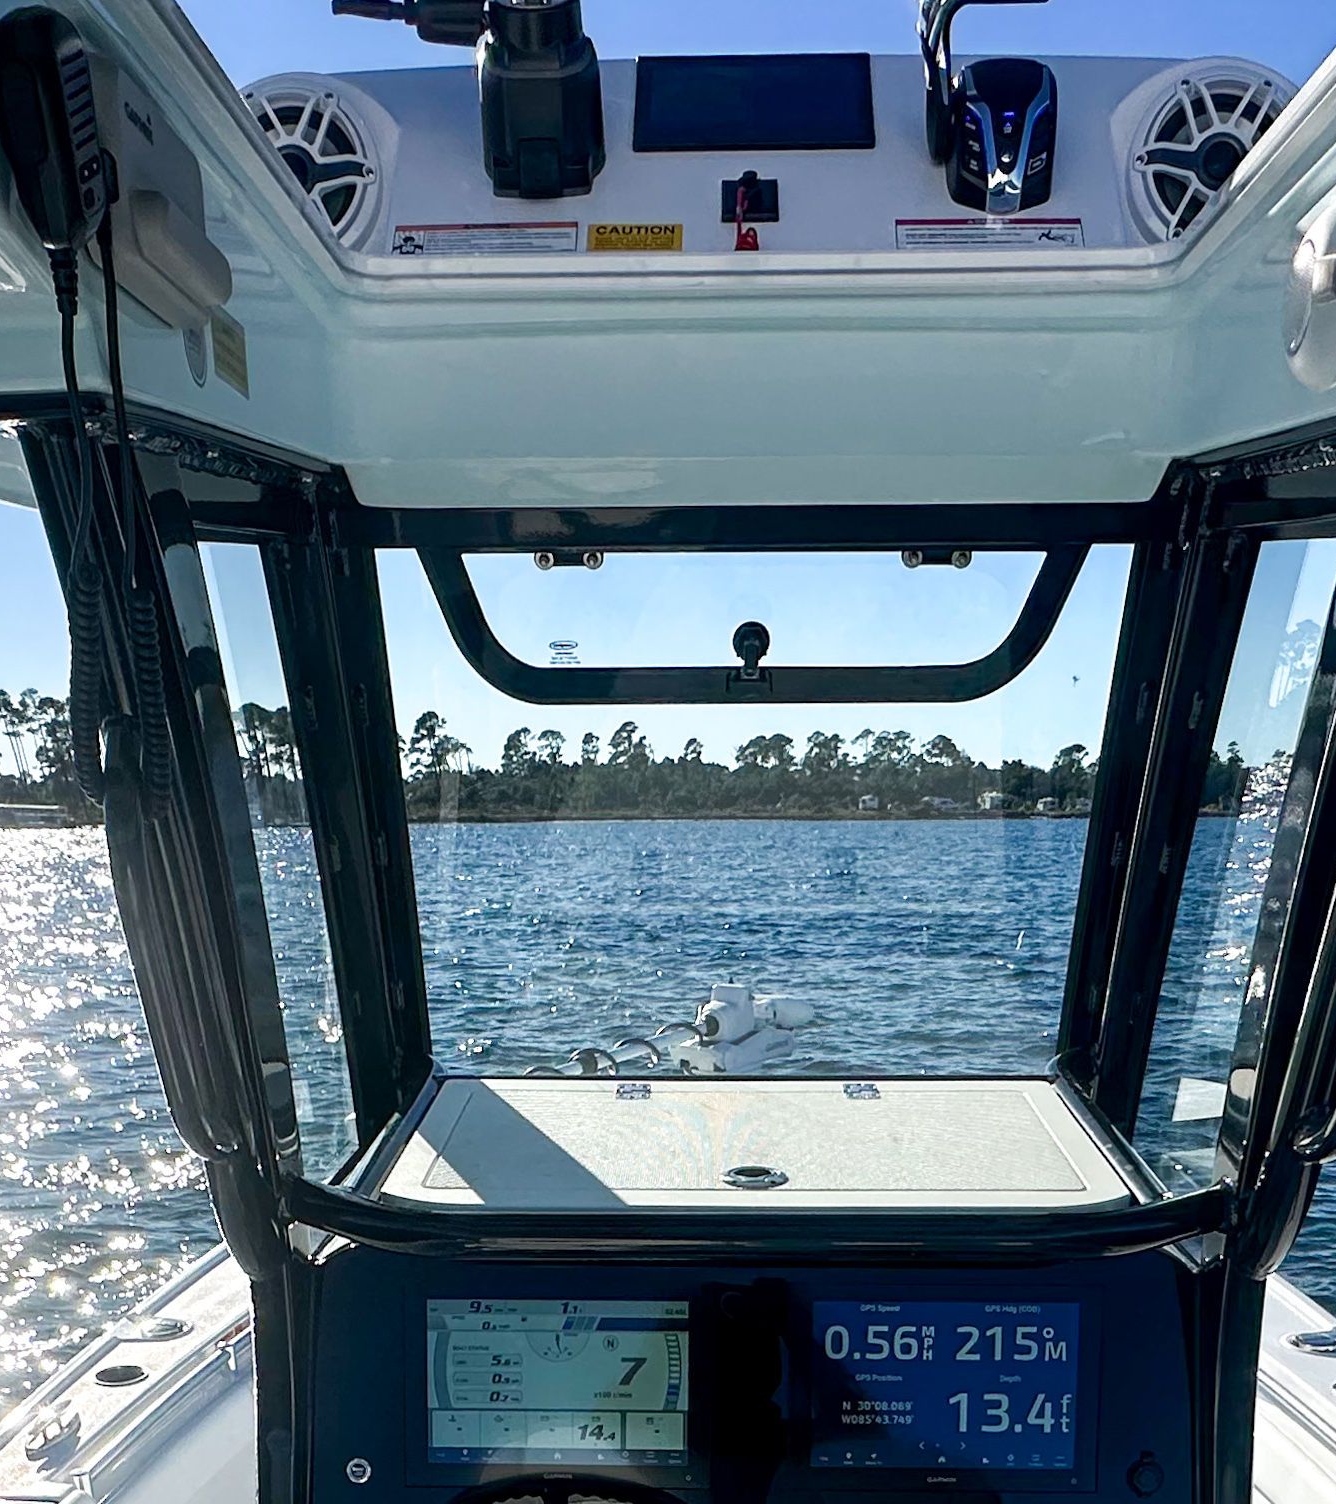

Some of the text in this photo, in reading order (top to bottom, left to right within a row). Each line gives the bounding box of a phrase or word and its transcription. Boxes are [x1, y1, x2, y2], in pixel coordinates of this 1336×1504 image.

[595, 225, 676, 236] CAUTION
[468, 1300, 493, 1313] 9.5
[560, 1301, 578, 1315] 1.1
[608, 1338, 615, 1350] N
[824, 1325, 918, 1361] 0.56
[619, 1357, 648, 1386] 7
[843, 1401, 851, 1410] N
[948, 1392, 1055, 1433] 13.4
[578, 1424, 616, 1441] 14.4
